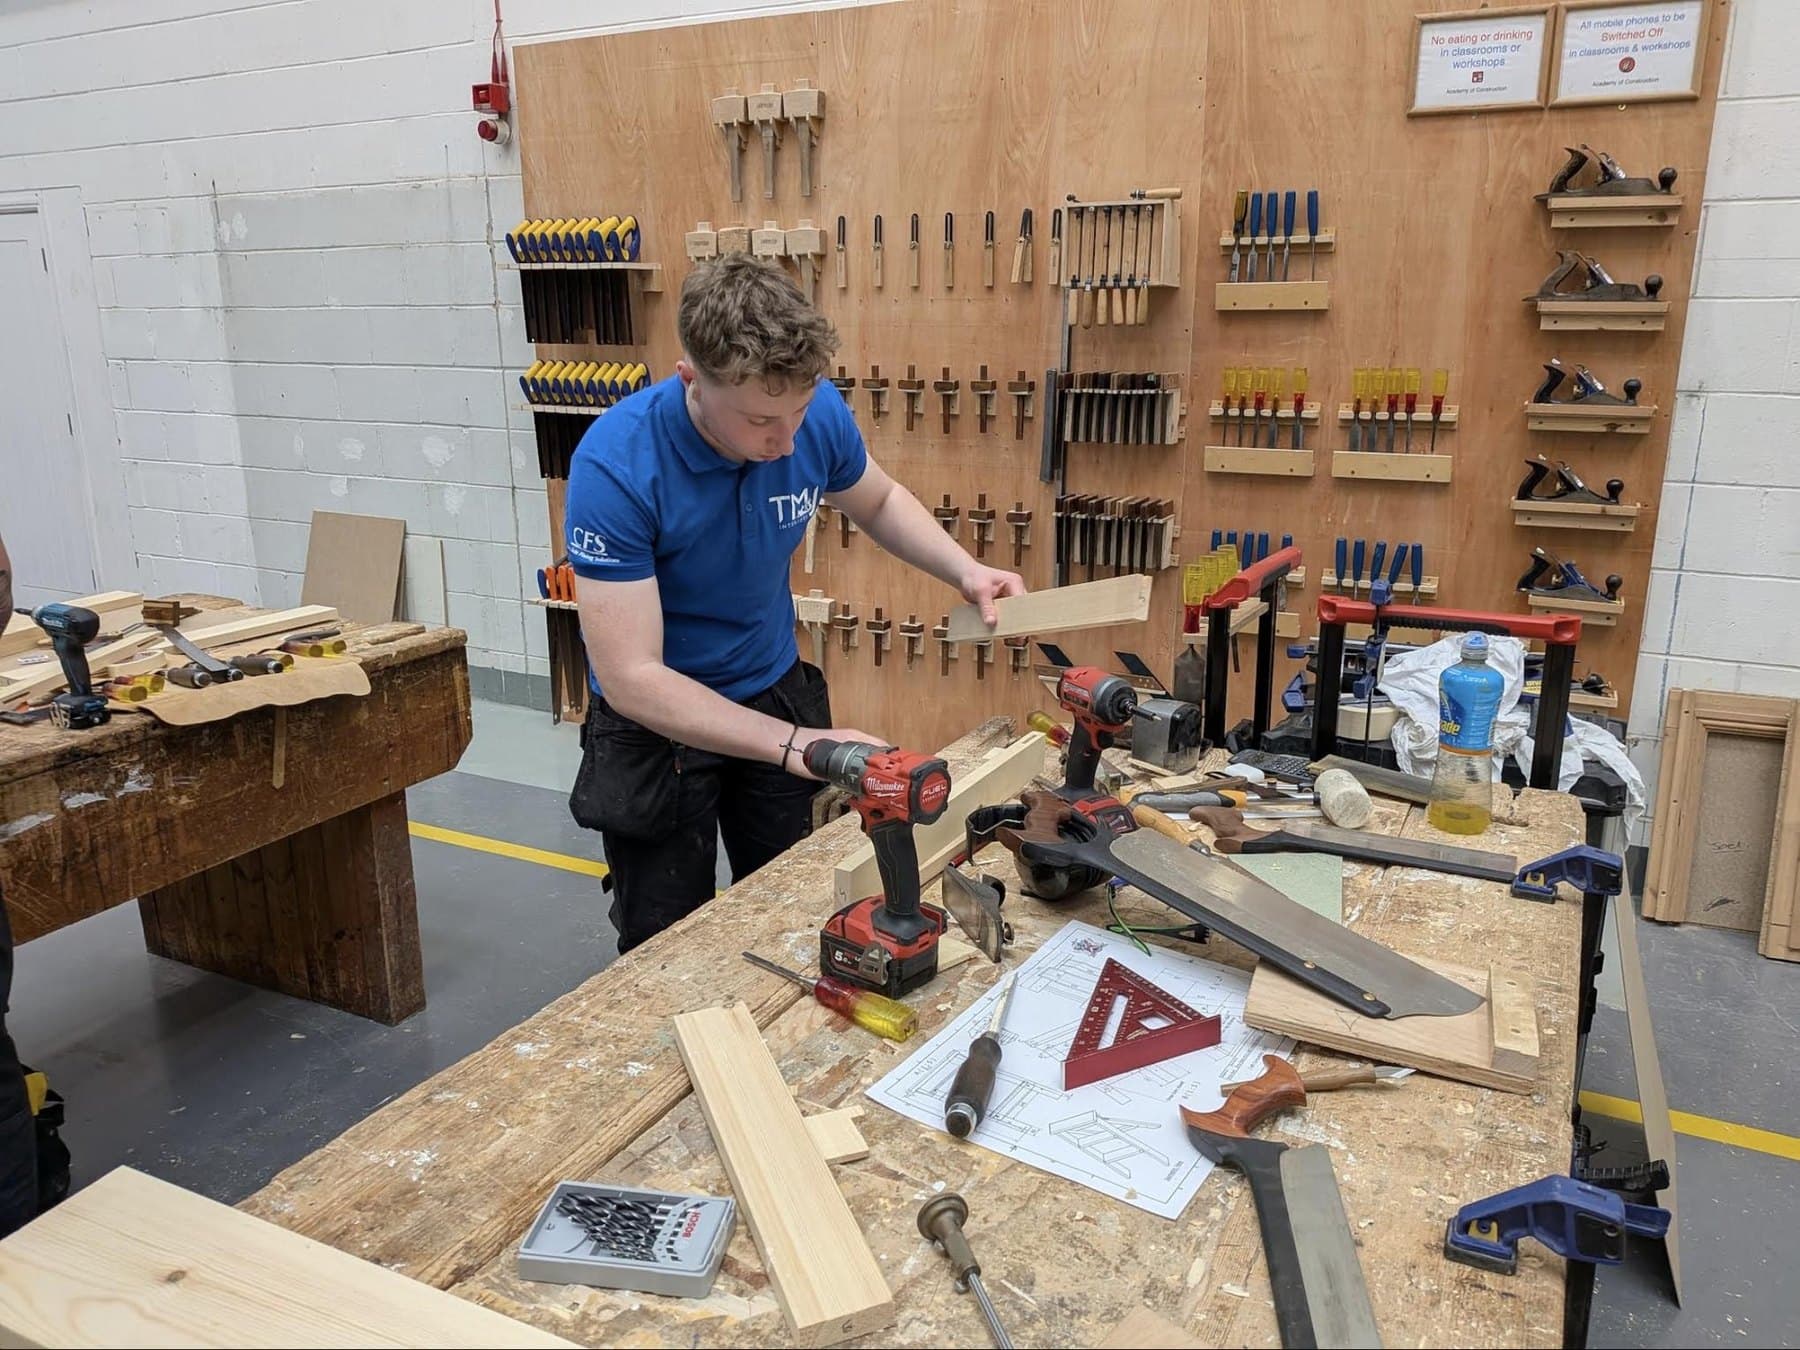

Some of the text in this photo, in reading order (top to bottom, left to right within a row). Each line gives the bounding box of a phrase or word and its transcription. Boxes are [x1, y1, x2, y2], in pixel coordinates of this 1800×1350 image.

[1580, 12, 1685, 30] All mobile phones to be
[1431, 30, 1533, 45] No eating or drinking
[1601, 27, 1664, 42] Switched Off
[1440, 44, 1521, 57] in classrooms or
[1569, 40, 1691, 57] in classrooms & workshops
[1452, 57, 1505, 69] workshops
[573, 527, 607, 553] CFS
[863, 776, 905, 791] Milwaukee
[922, 783, 947, 797] FUEL
[682, 1212, 701, 1238] BOSCH
